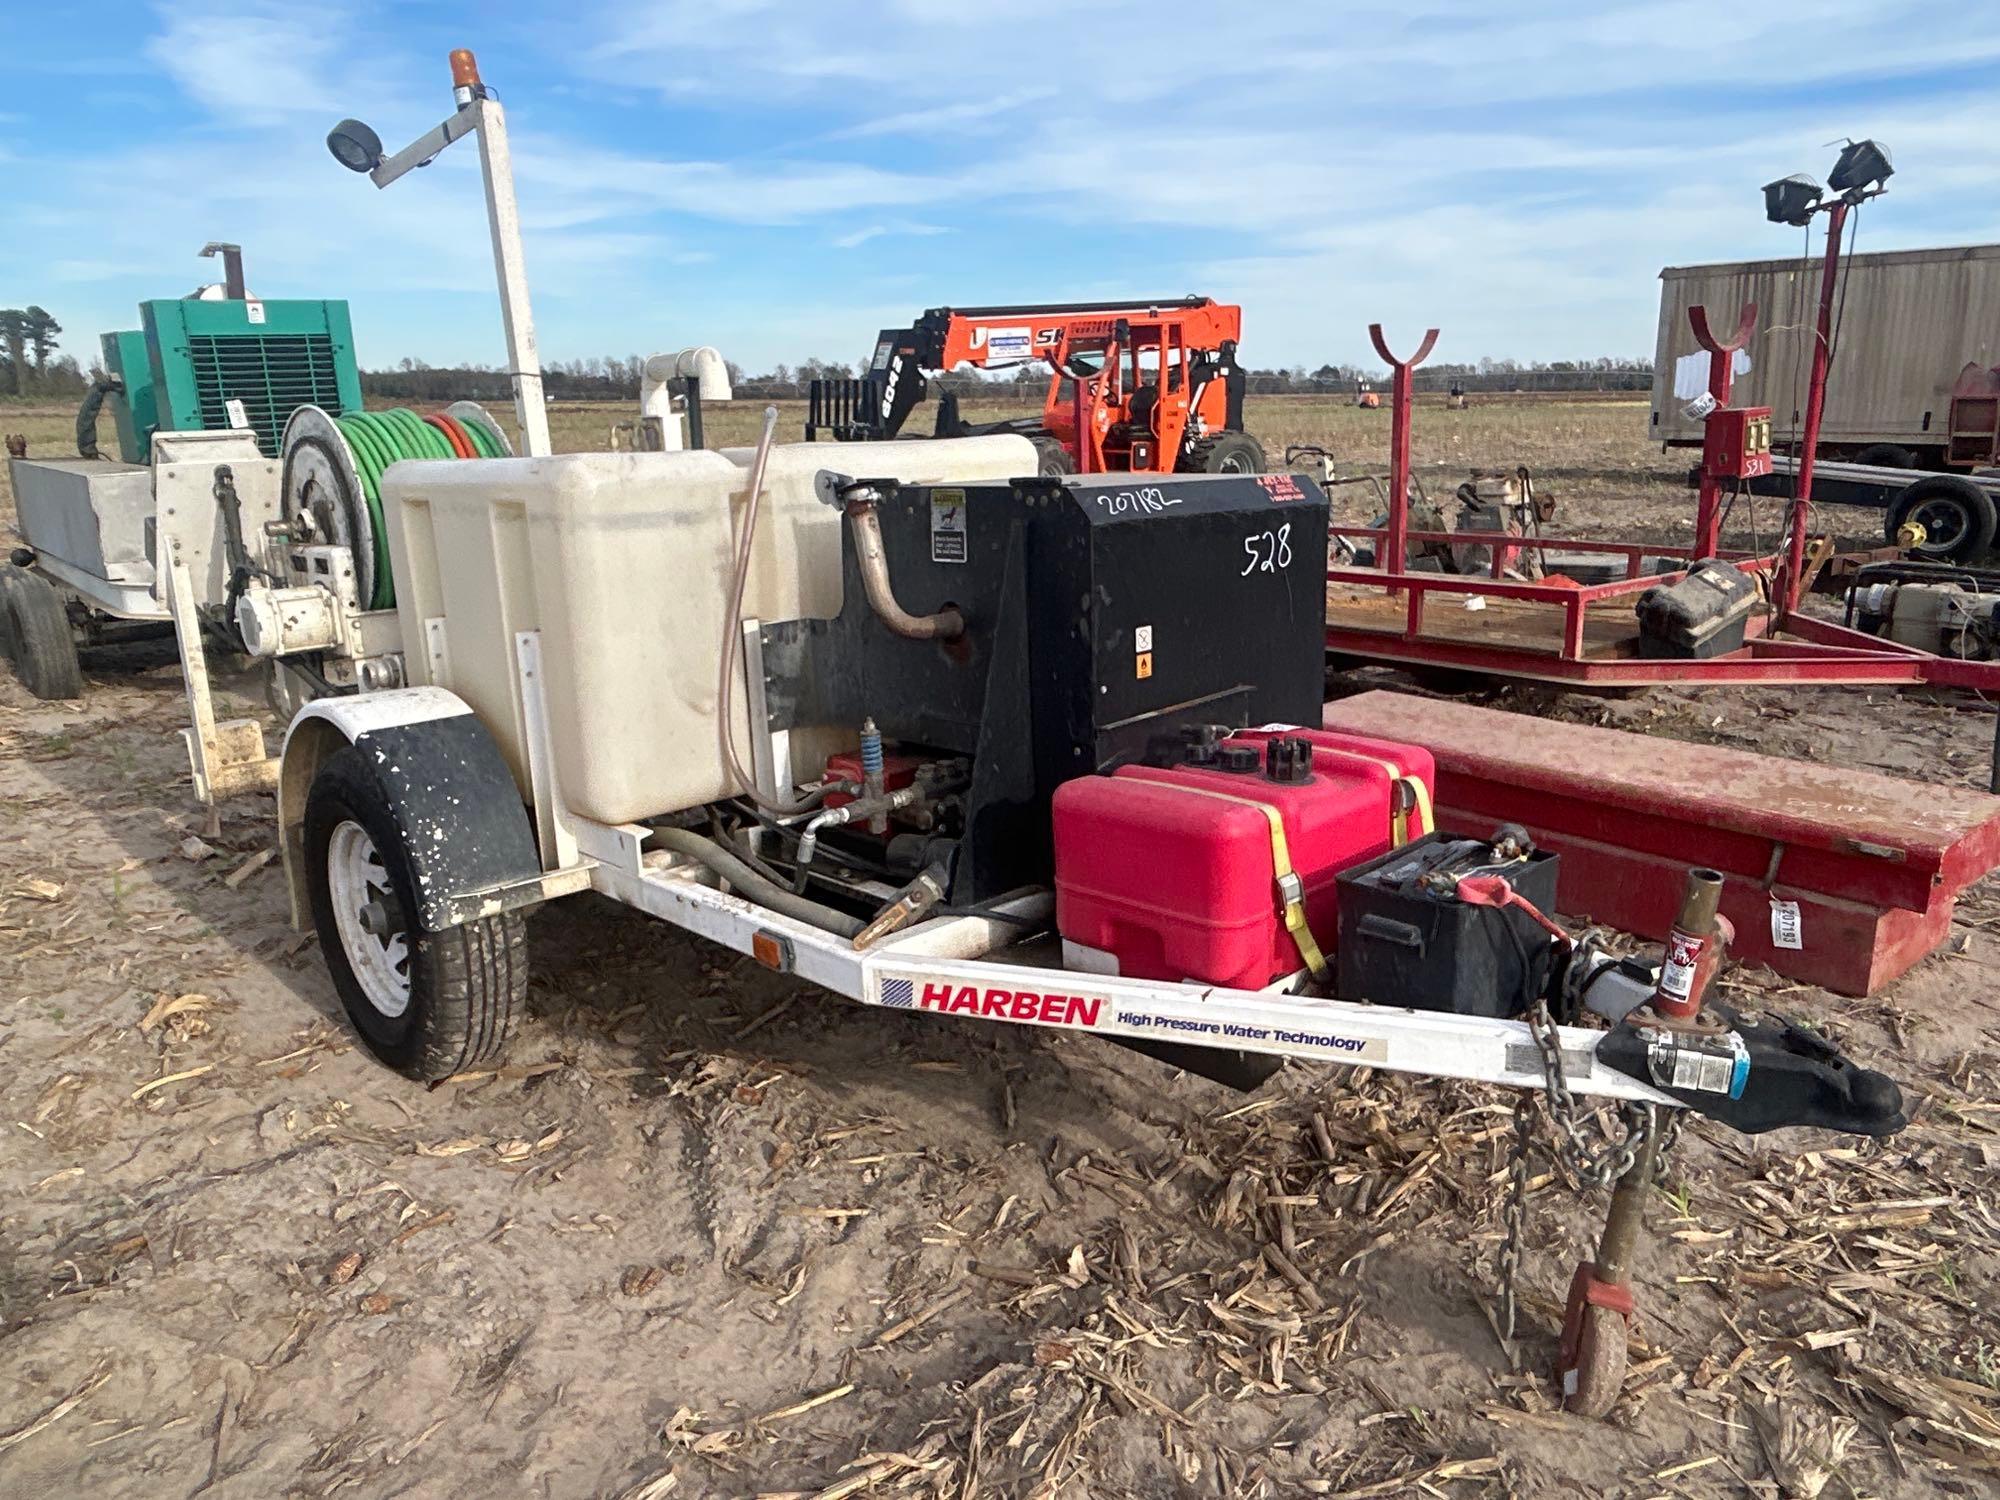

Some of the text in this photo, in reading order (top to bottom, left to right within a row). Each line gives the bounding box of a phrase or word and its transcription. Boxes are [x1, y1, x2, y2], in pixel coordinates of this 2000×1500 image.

[1744, 459, 1764, 476] 531
[1241, 522, 1292, 576] 528
[1782, 909, 1796, 943] 207193
[920, 983, 1102, 1026] HARBEN
[1117, 1012, 1367, 1052] High Pressure Water Technology
